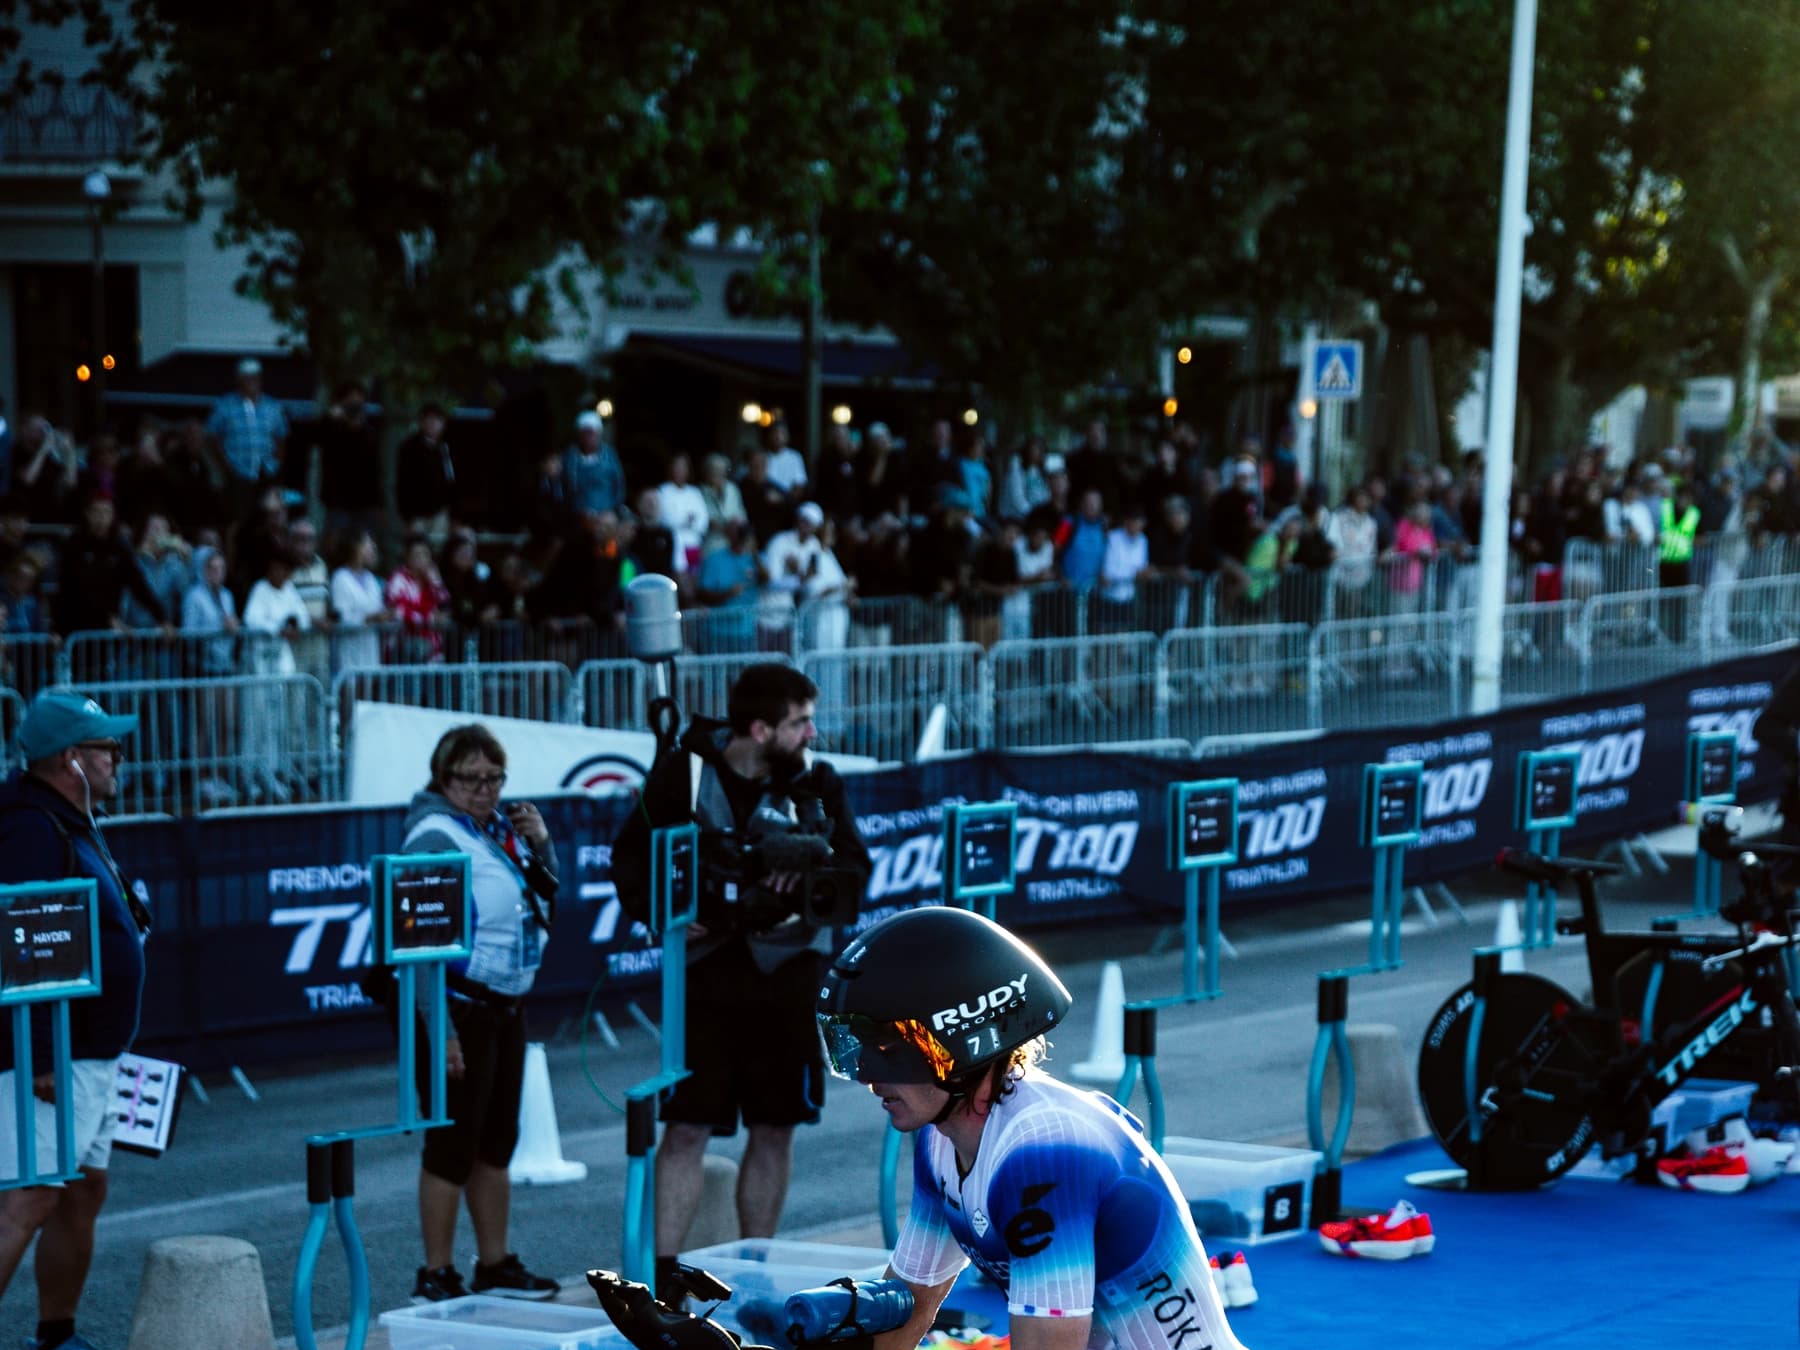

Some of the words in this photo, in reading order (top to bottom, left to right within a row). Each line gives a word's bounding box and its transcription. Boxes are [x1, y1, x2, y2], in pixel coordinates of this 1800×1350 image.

[1543, 728, 1646, 786] 100
[1421, 758, 1492, 819] 100
[1239, 795, 1328, 859] 100
[14, 927, 26, 944] 3
[932, 973, 1028, 1031] RUDY
[946, 994, 1027, 1037] PROJECT
[1656, 986, 1758, 1087] TREK
